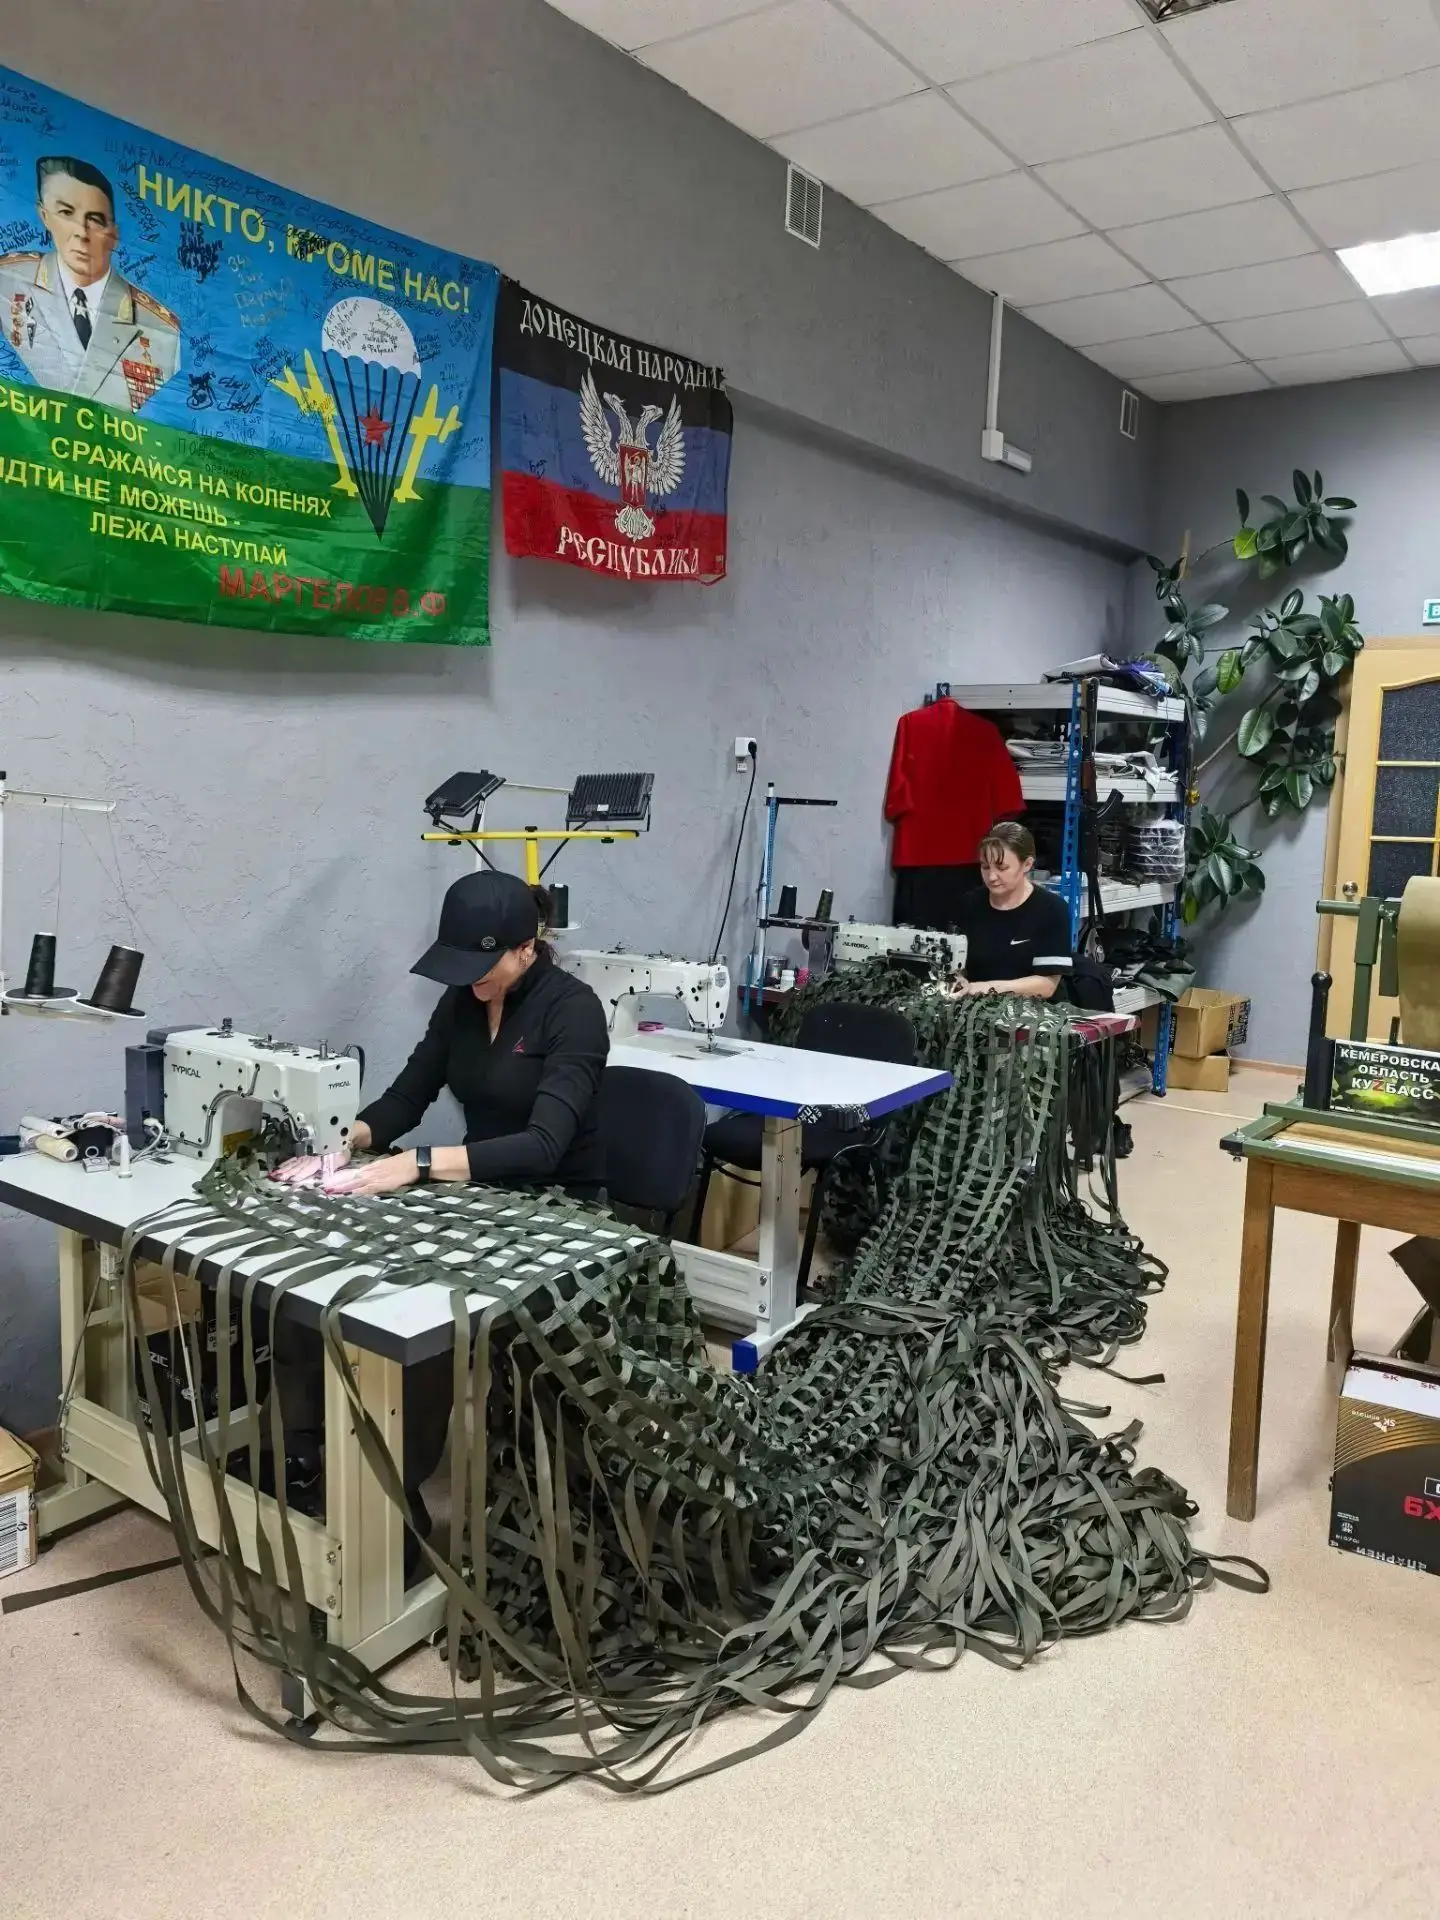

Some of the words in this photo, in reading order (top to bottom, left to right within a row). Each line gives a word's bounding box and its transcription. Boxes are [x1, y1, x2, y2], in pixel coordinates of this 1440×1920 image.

[138, 164, 275, 253] НИКТО,
[286, 223, 396, 291] КРОМЕ
[404, 267, 470, 313] НАС!
[520, 300, 632, 373] ДОНЕЦКАЯ
[76, 407, 95, 430] С
[104, 416, 148, 446] НОГ
[0, 456, 65, 493] ДТИ
[74, 473, 111, 502] НЕ
[120, 485, 229, 527] МОЖЕШЬ
[51, 437, 194, 488] СРАЖАЙСЯ
[199, 473, 232, 499] НА
[236, 483, 332, 518] КОЛЕНЯХ
[90, 511, 166, 546] ЛЕЖА
[175, 527, 288, 567] НАСТУПАЙ
[555, 525, 700, 579] РЕСПУБЛИКА
[171, 1063, 201, 1079] TYPICAL
[328, 1080, 352, 1091] TYPICAL
[1358, 1064, 1430, 1084] ОБЛАСТЬ
